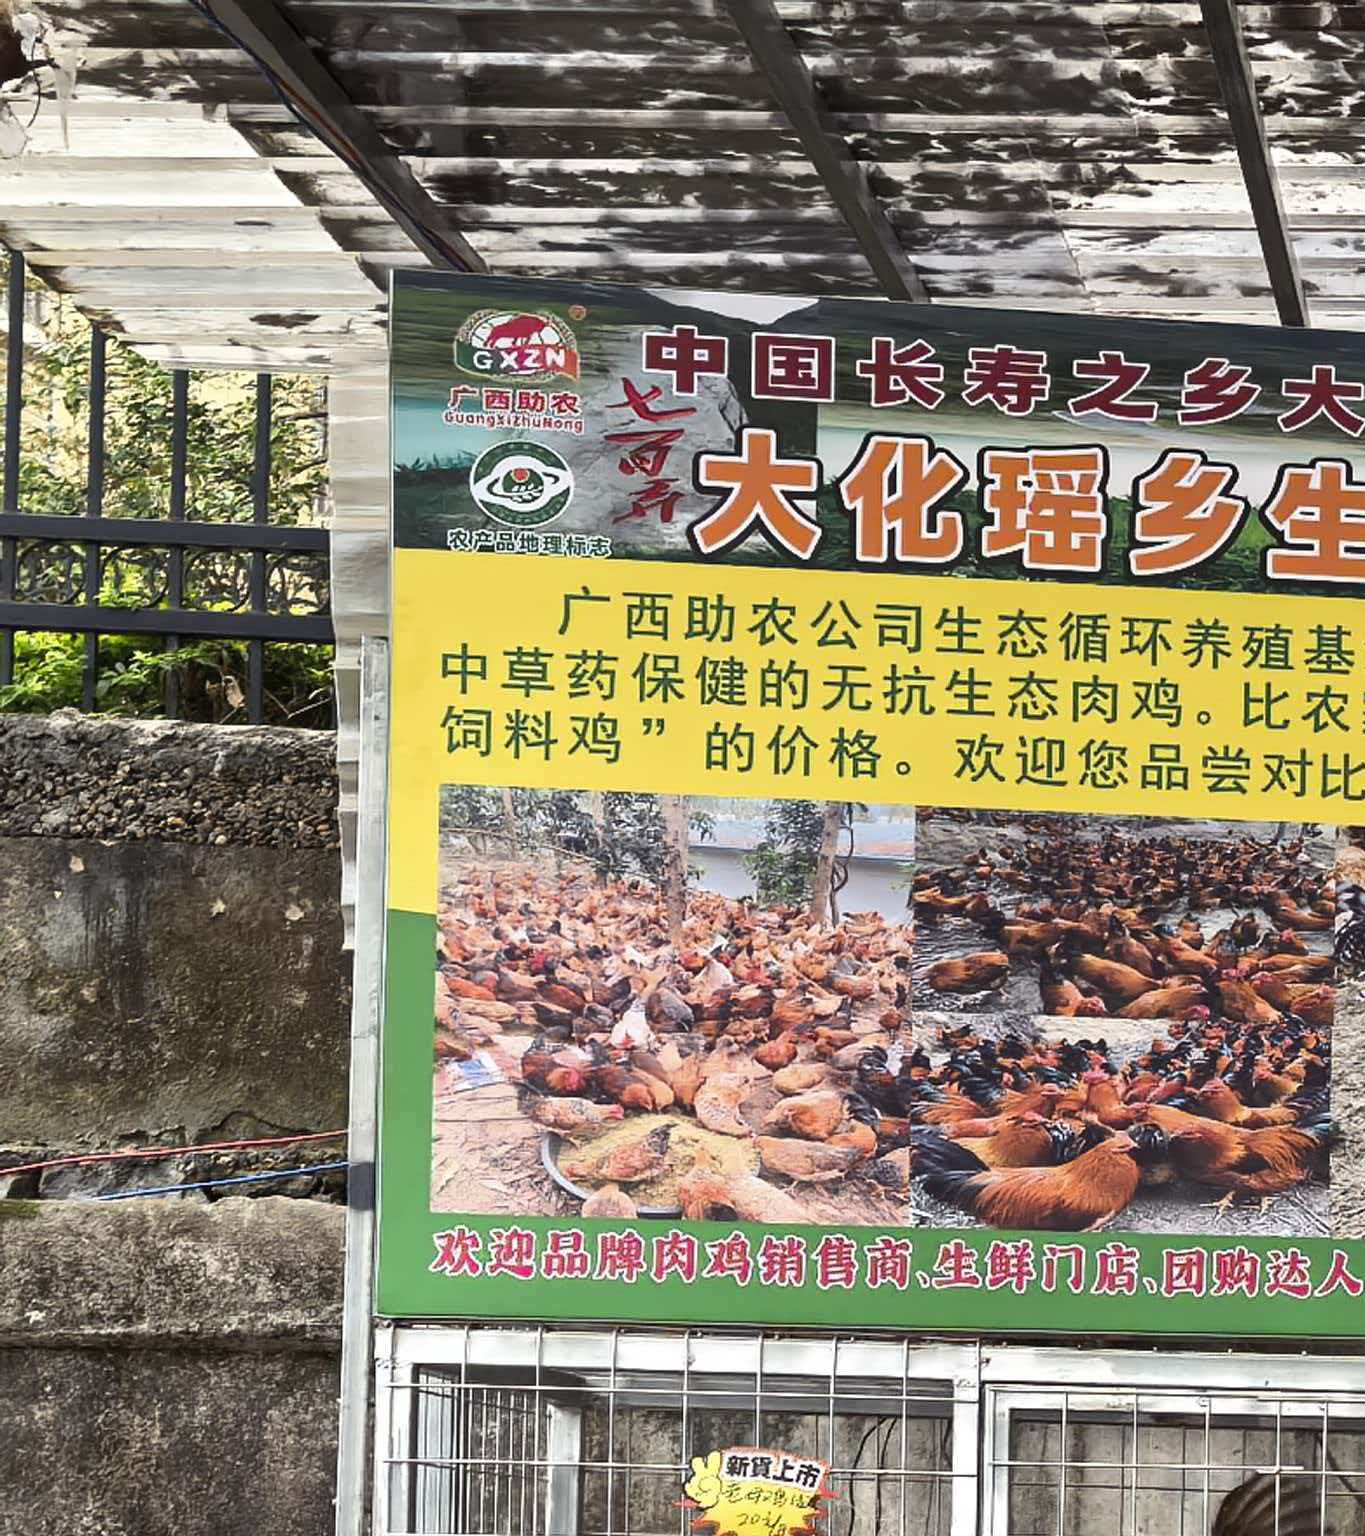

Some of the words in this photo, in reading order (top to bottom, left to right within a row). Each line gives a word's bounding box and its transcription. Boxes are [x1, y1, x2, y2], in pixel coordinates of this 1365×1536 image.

[473, 348, 567, 369] GXZN
[448, 385, 581, 415] 广西助农
[604, 377, 697, 524] 七百弄
[447, 528, 613, 558] 农产品地理标志
